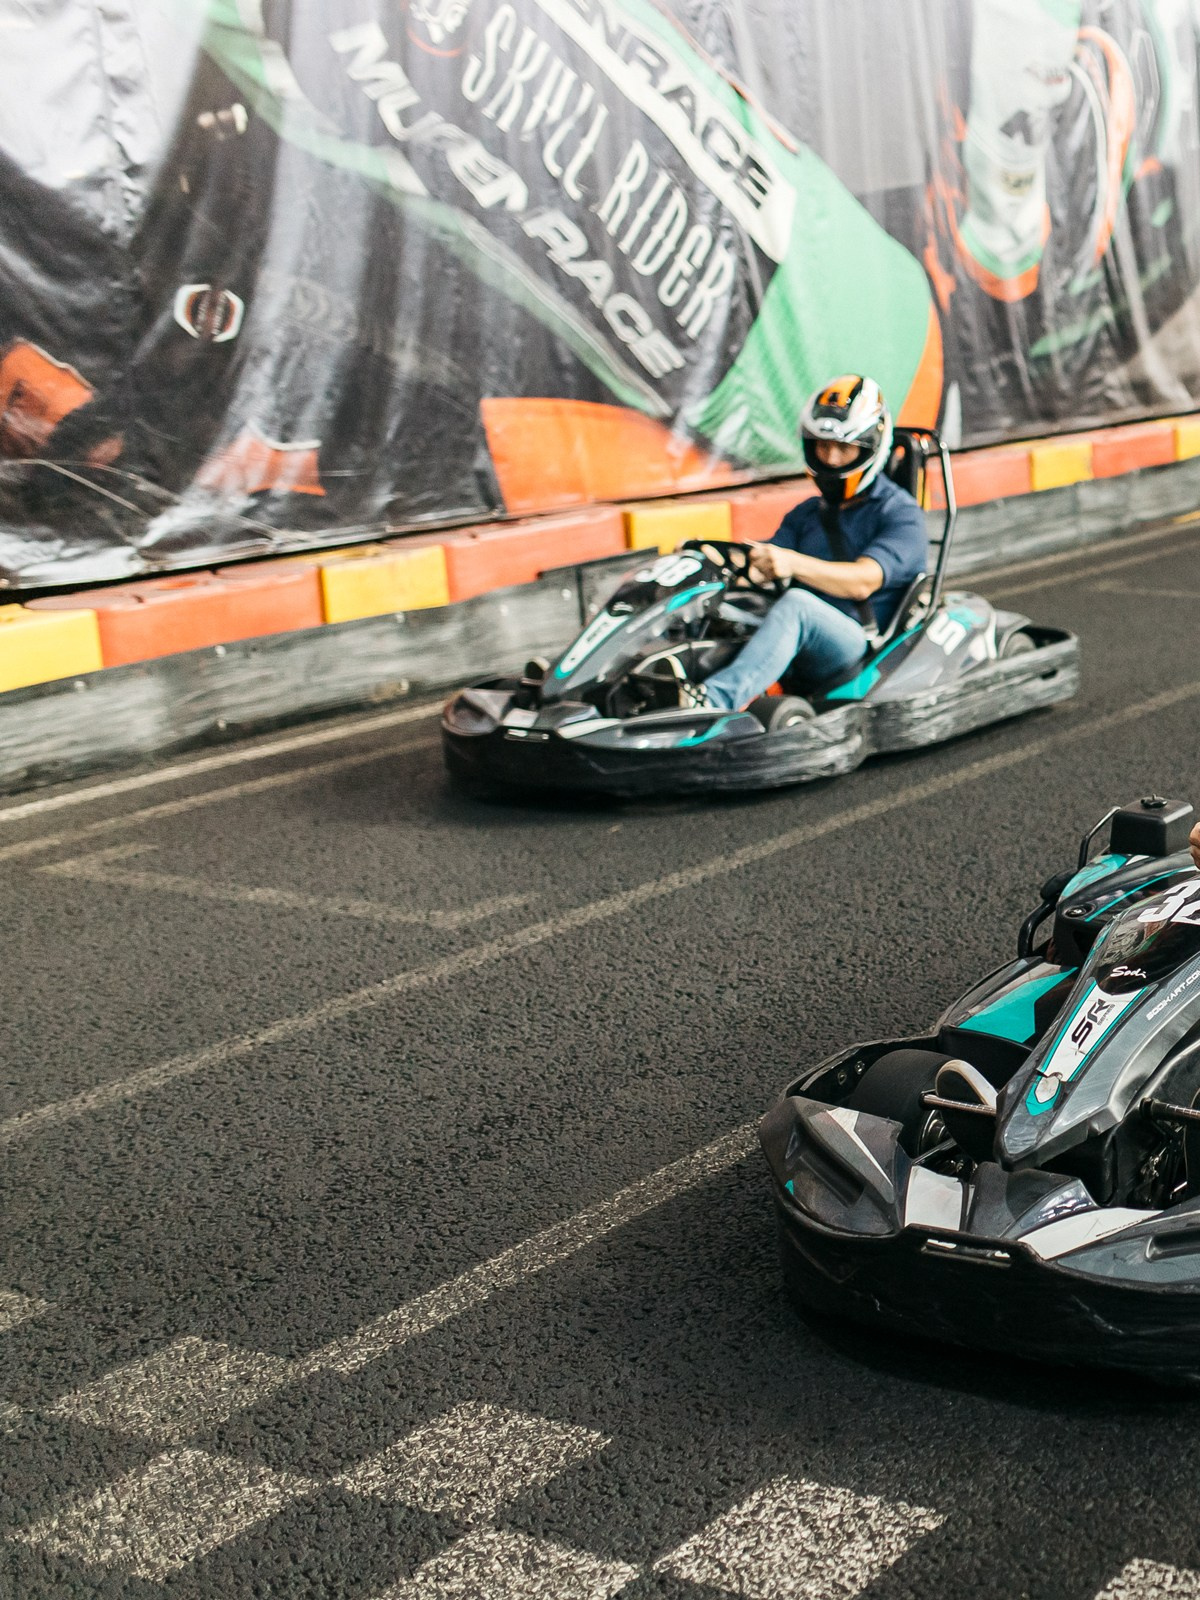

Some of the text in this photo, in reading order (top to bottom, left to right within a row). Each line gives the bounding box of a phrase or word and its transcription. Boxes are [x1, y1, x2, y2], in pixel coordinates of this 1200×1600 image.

[518, 208, 687, 380] RACE
[597, 139, 736, 340] RIDER
[1070, 998, 1112, 1049] SR
